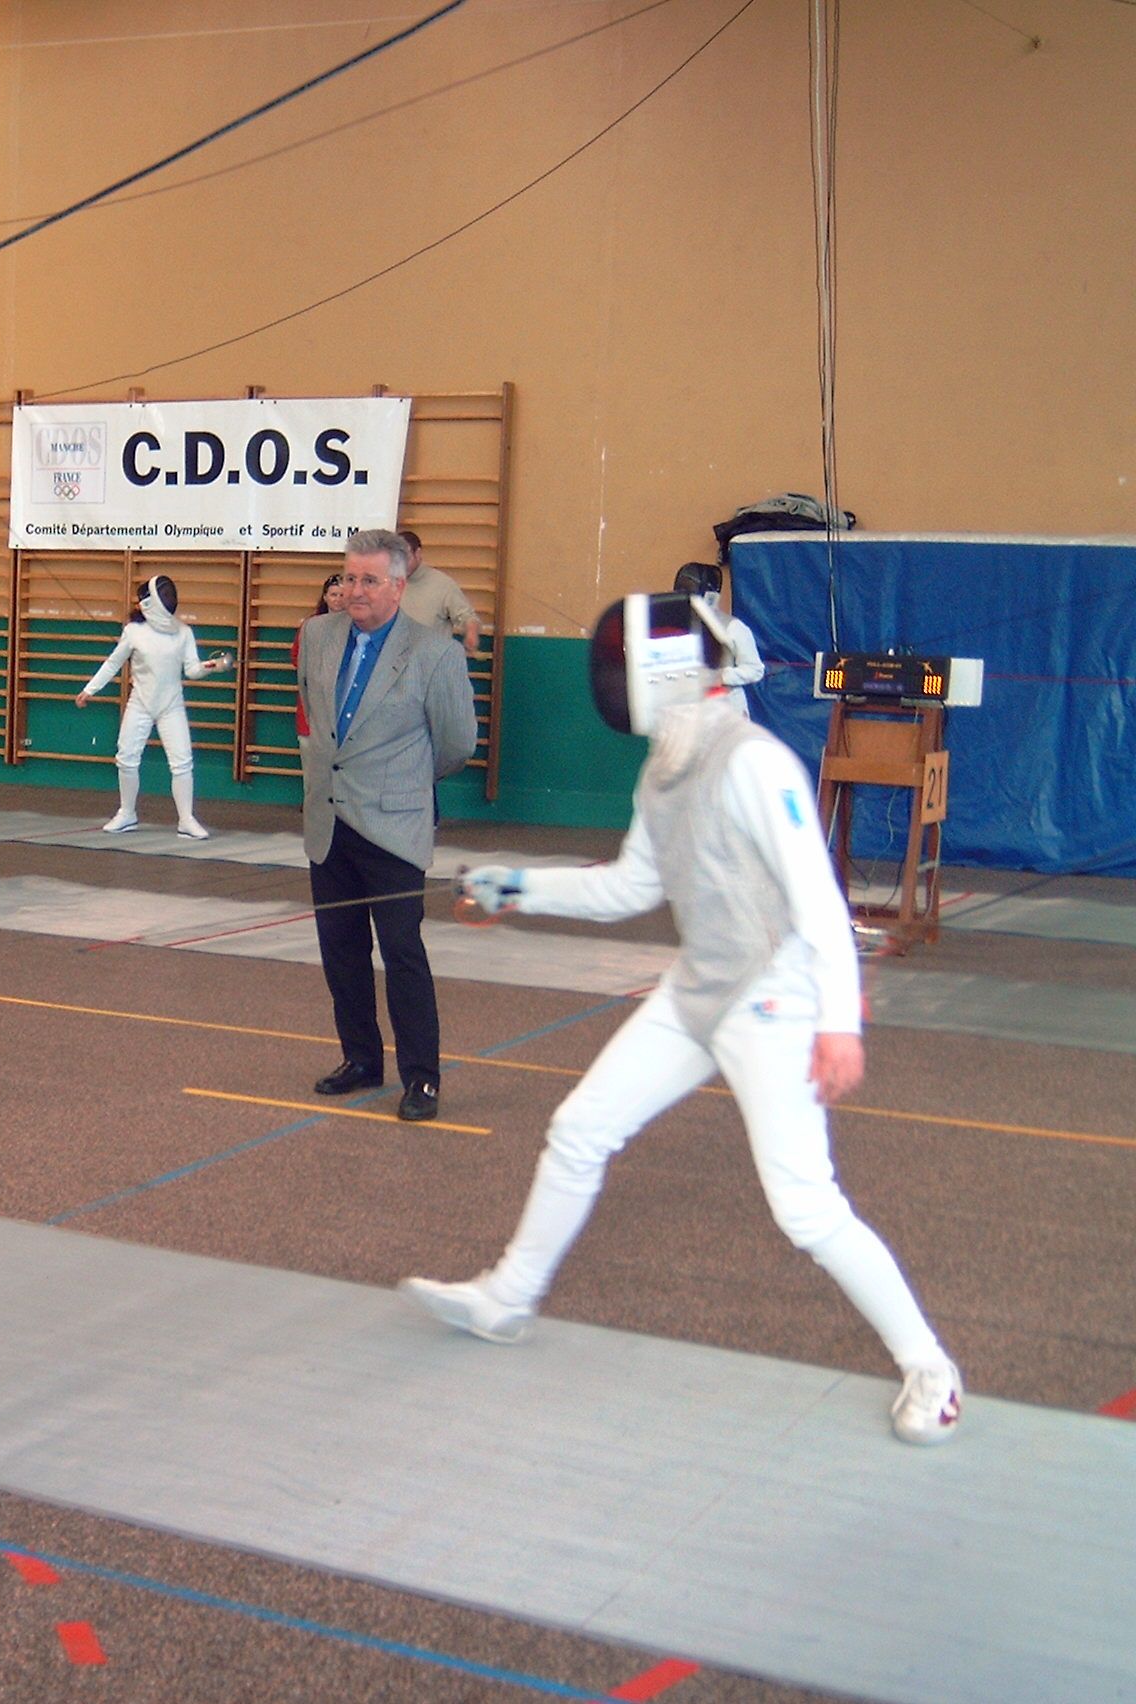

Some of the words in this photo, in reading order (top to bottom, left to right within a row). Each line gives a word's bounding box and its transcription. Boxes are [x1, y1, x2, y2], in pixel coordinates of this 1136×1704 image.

[121, 428, 368, 486] C.D.O.S.
[53, 471, 81, 484] FRANCE
[25, 523, 68, 535] Comité
[71, 523, 158, 537] Départemental
[164, 523, 224, 538] Olympique
[239, 524, 253, 536] et
[262, 524, 305, 538] Sportif
[311, 526, 327, 538] de
[331, 526, 342, 538] la
